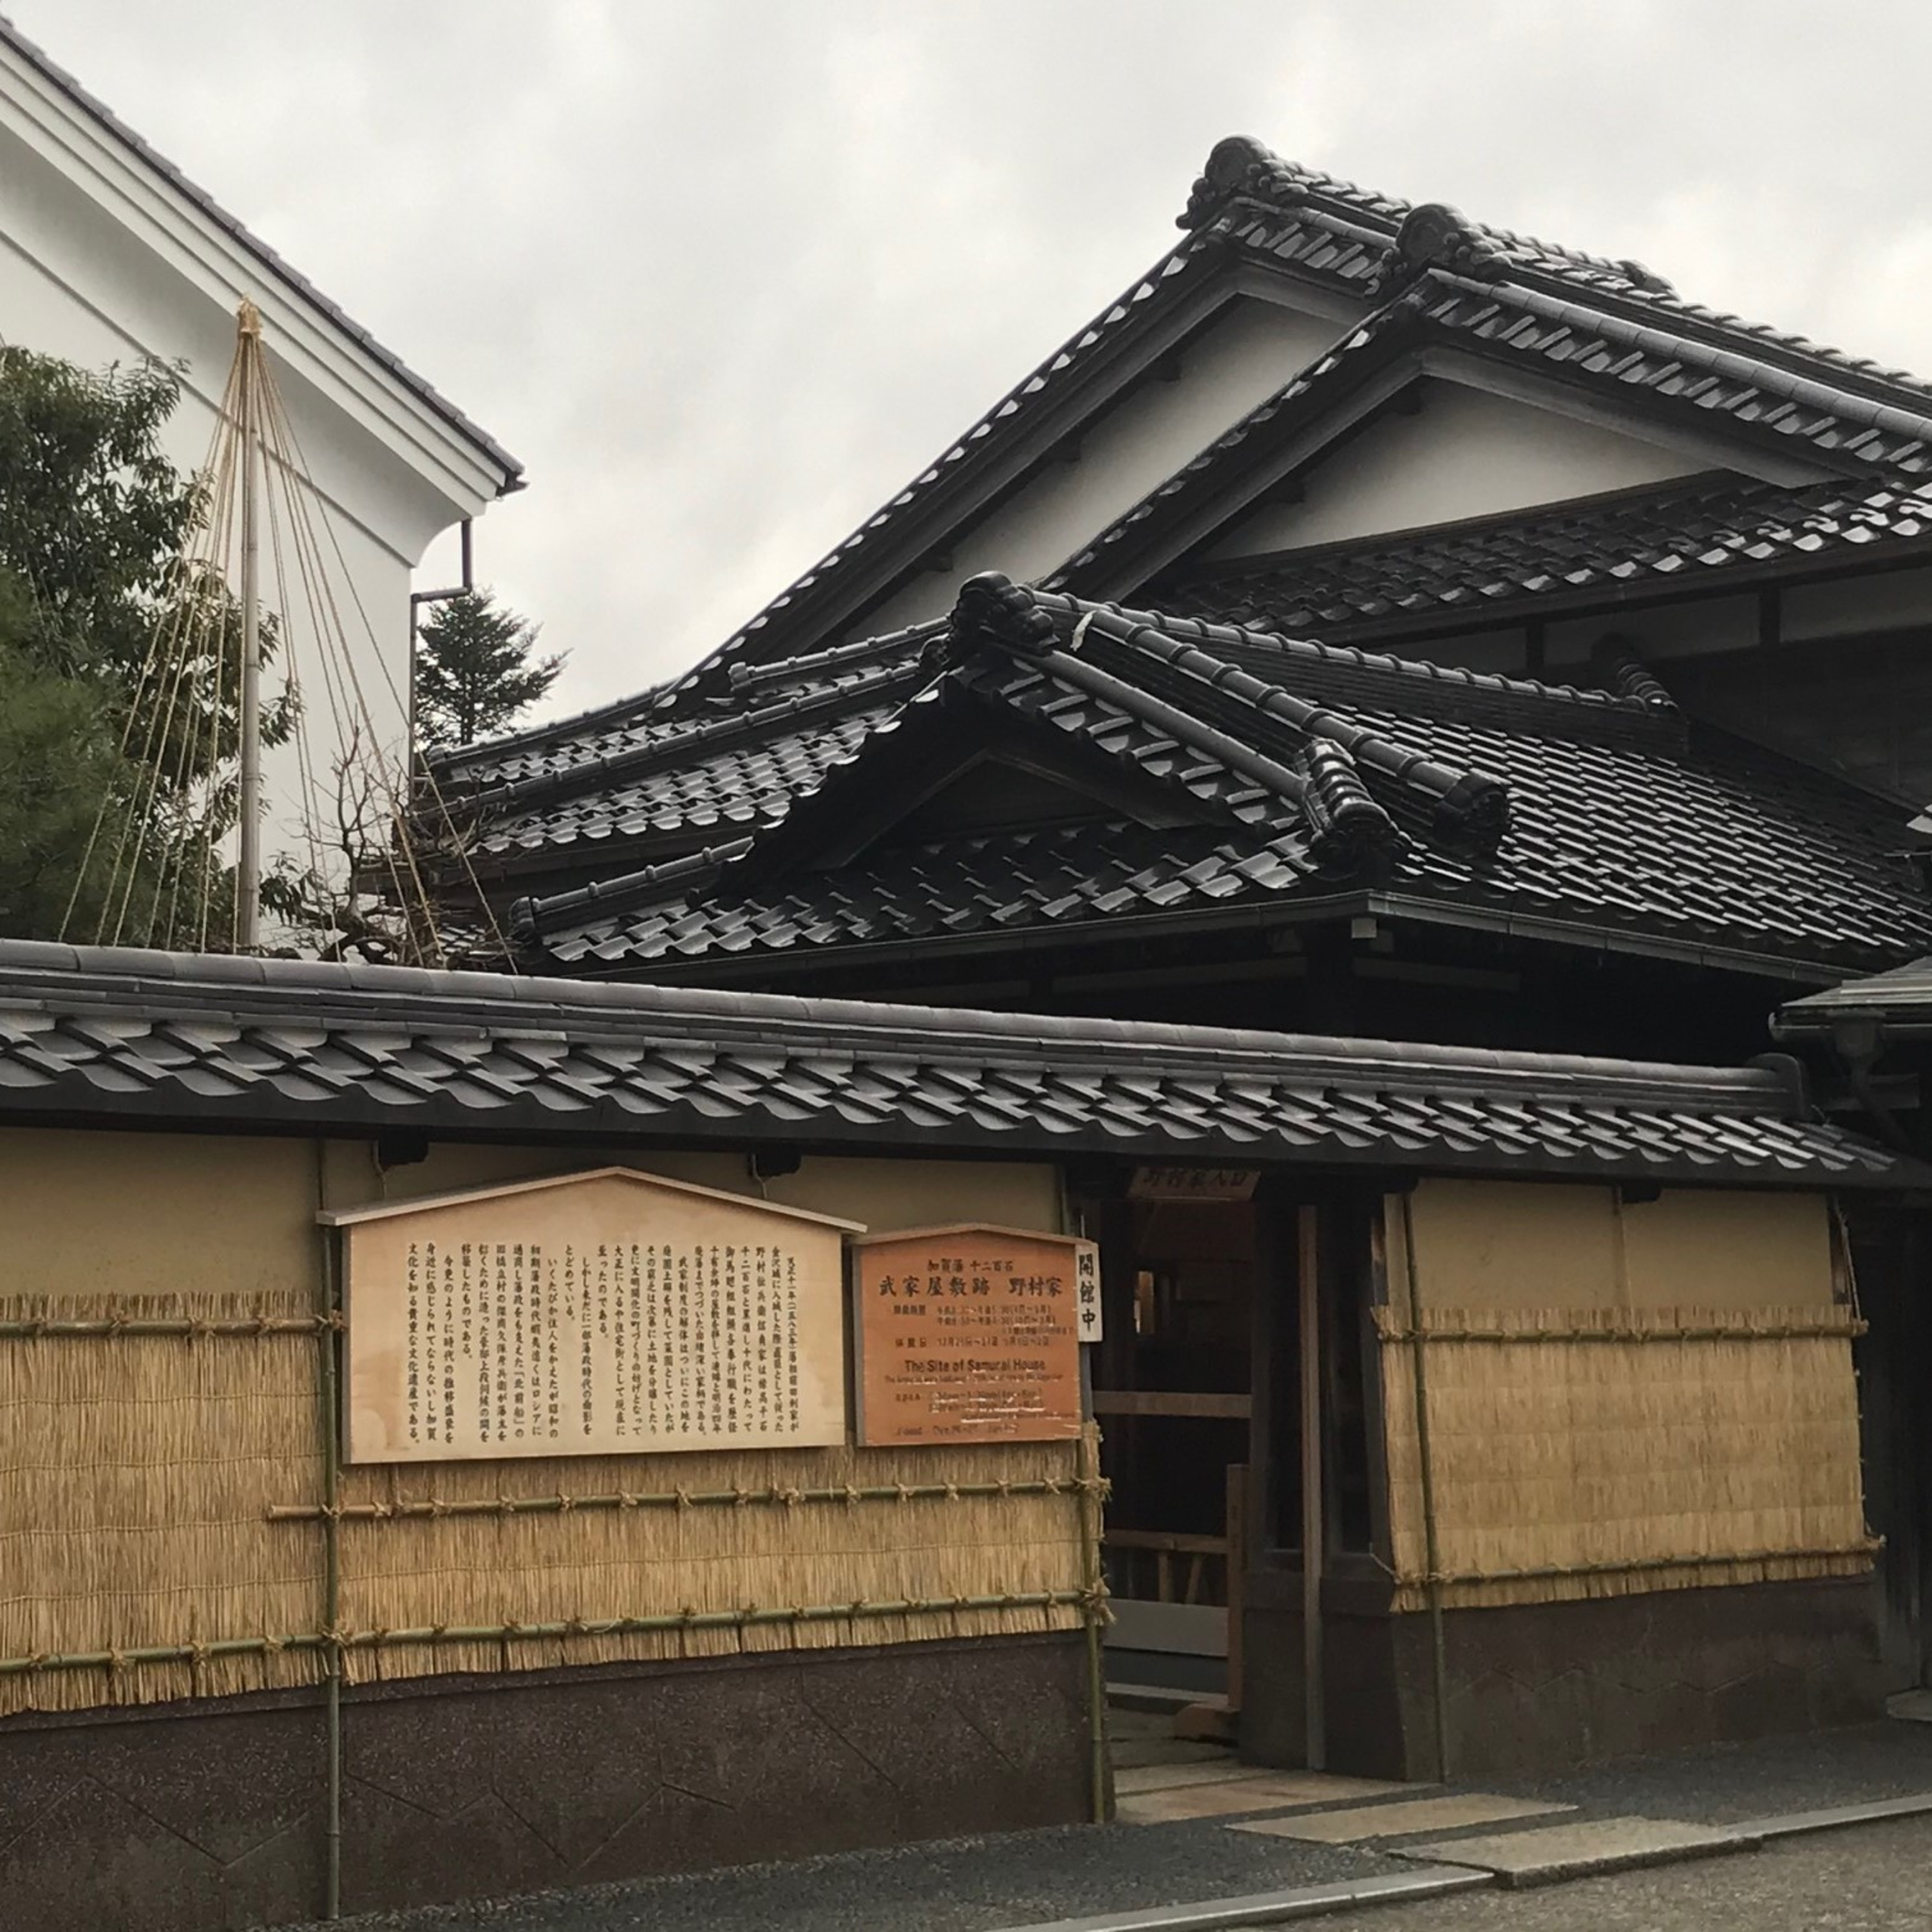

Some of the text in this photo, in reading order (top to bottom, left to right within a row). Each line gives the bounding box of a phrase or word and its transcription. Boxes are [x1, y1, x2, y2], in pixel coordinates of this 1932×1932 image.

[461, 1243, 473, 1359] 移築したものである。
[565, 1245, 576, 1320] とどめている。
[598, 1244, 610, 1338] 至ったのである。
[878, 1276, 1063, 1297] 武家屋敷跡 野村家
[927, 1259, 963, 1273] 加賀藩
[1079, 1253, 1096, 1331] 開館中
[905, 1359, 1045, 1373] The Site of Samurai House
